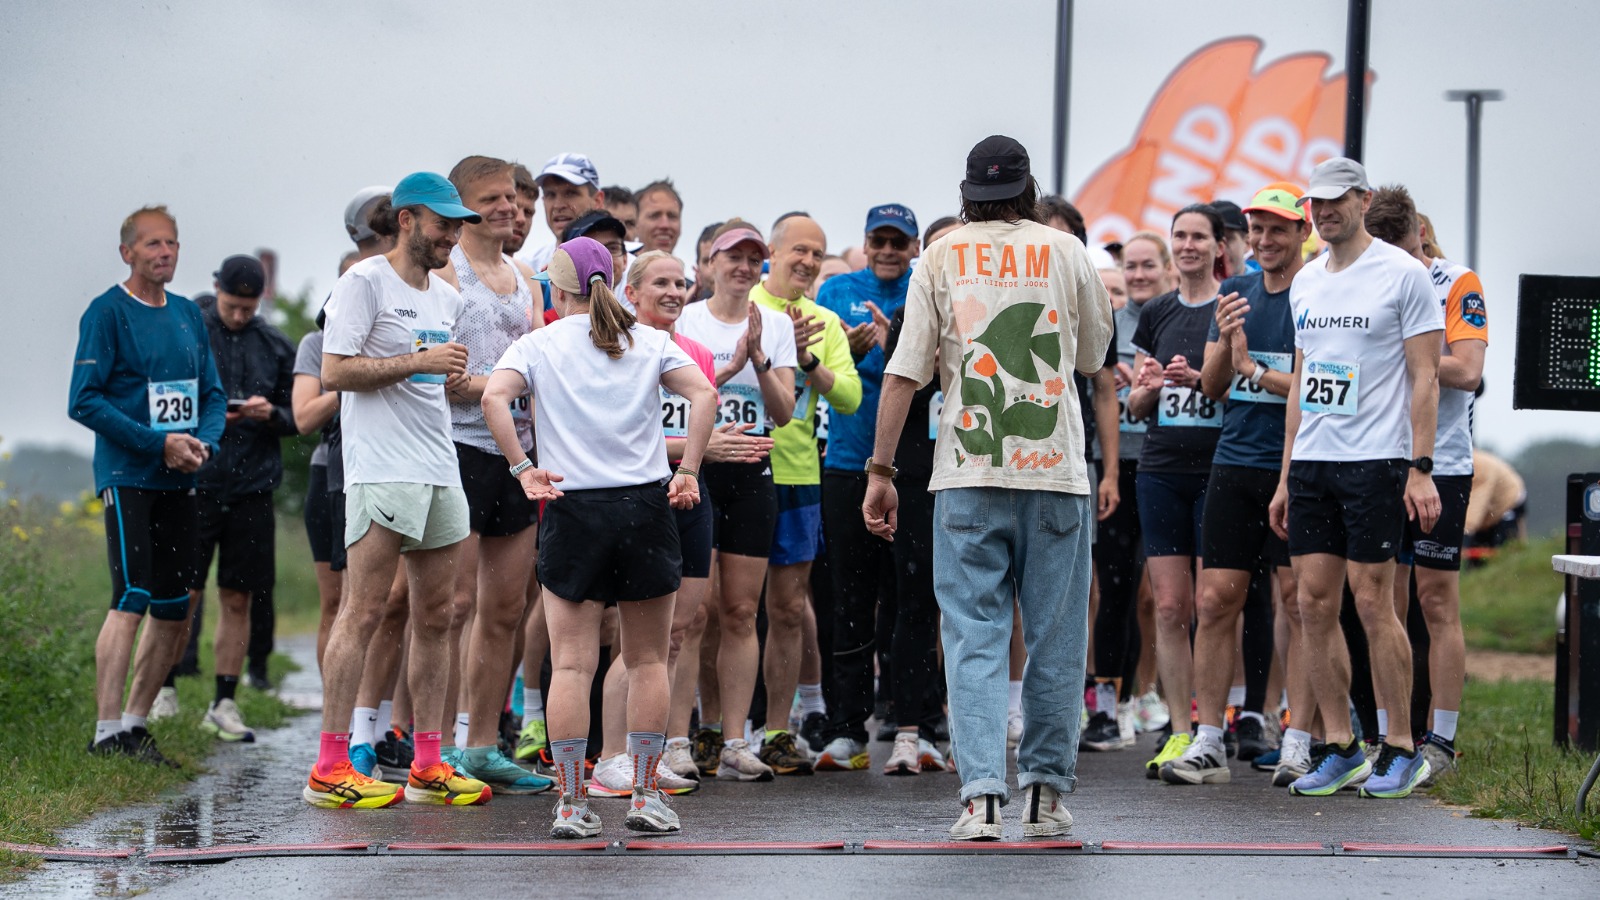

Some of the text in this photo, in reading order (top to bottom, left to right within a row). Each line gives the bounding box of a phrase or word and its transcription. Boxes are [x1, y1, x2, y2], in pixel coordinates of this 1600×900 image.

[951, 243, 1050, 279] TEAM
[956, 278, 1049, 289] KOPLI LIINIDE JOOKS
[1306, 316, 1370, 330] NUMERI
[1317, 362, 1353, 371] TRIATHLON
[1305, 377, 1351, 406] 257
[156, 396, 193, 423] 239
[661, 402, 692, 429] 21
[1165, 393, 1216, 419] 348
